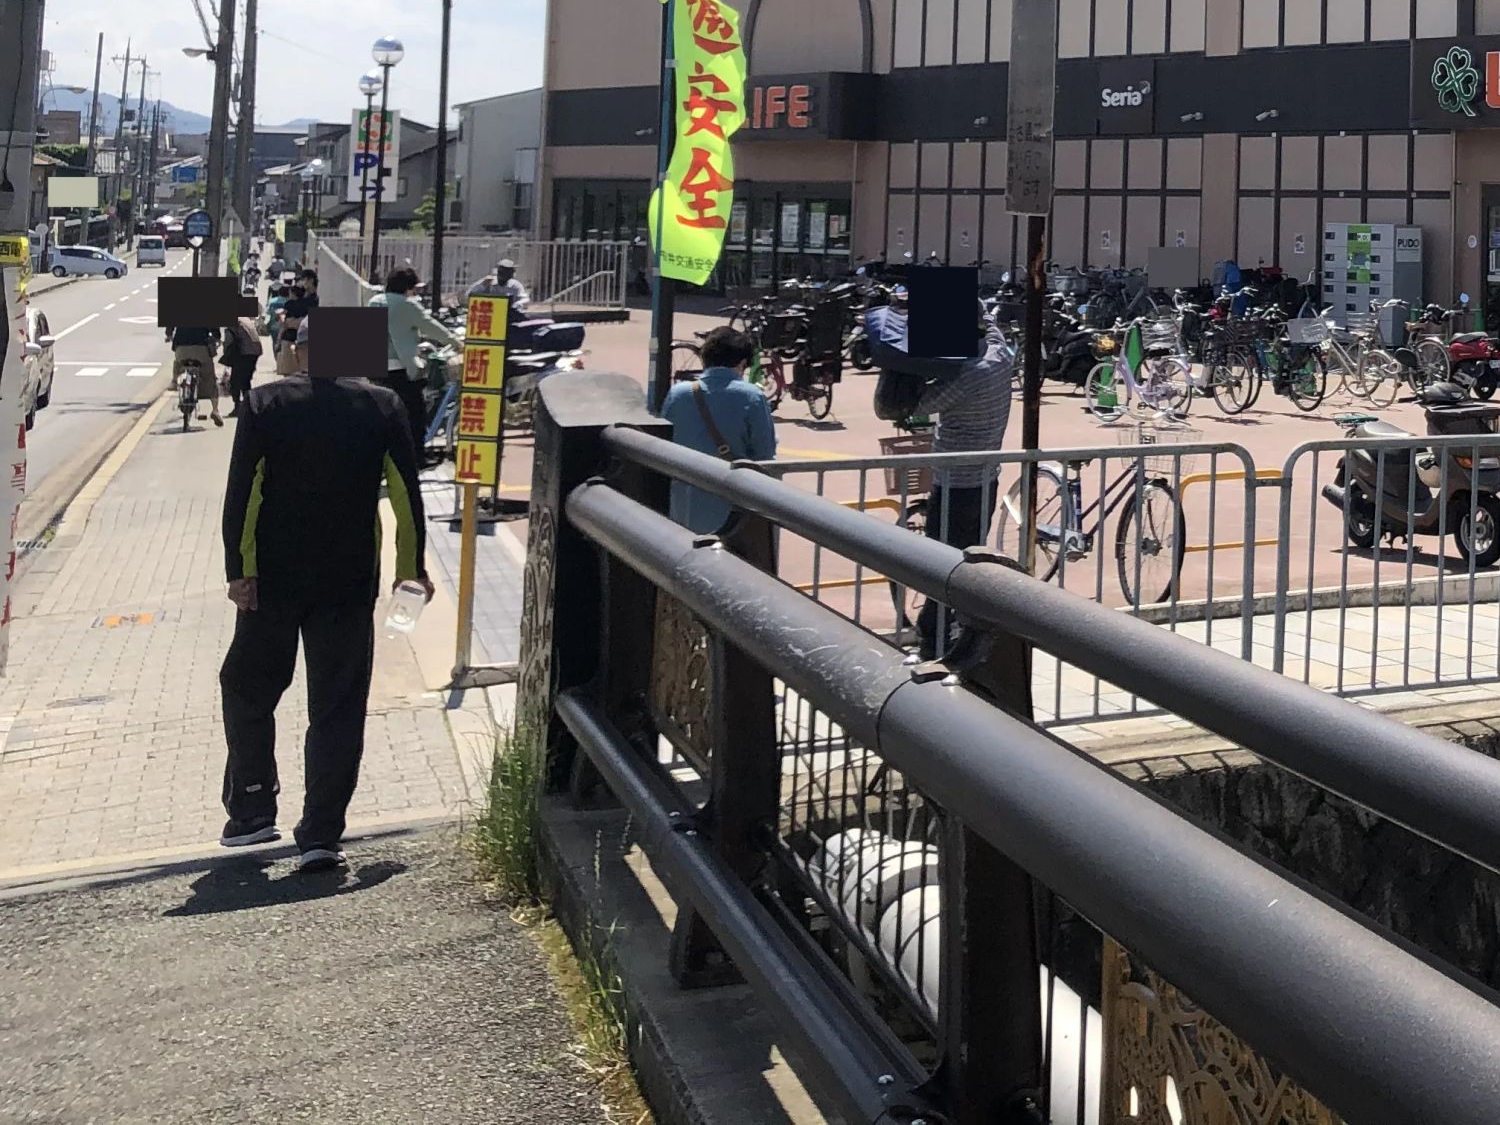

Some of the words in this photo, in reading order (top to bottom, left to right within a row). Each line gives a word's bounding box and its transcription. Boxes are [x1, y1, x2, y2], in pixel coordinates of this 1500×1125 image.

[740, 85, 810, 128] IFE
[1101, 85, 1142, 107] Seria
[353, 153, 380, 177] P
[1397, 238, 1420, 248] PUDO
[458, 299, 494, 481] 横断禁止
